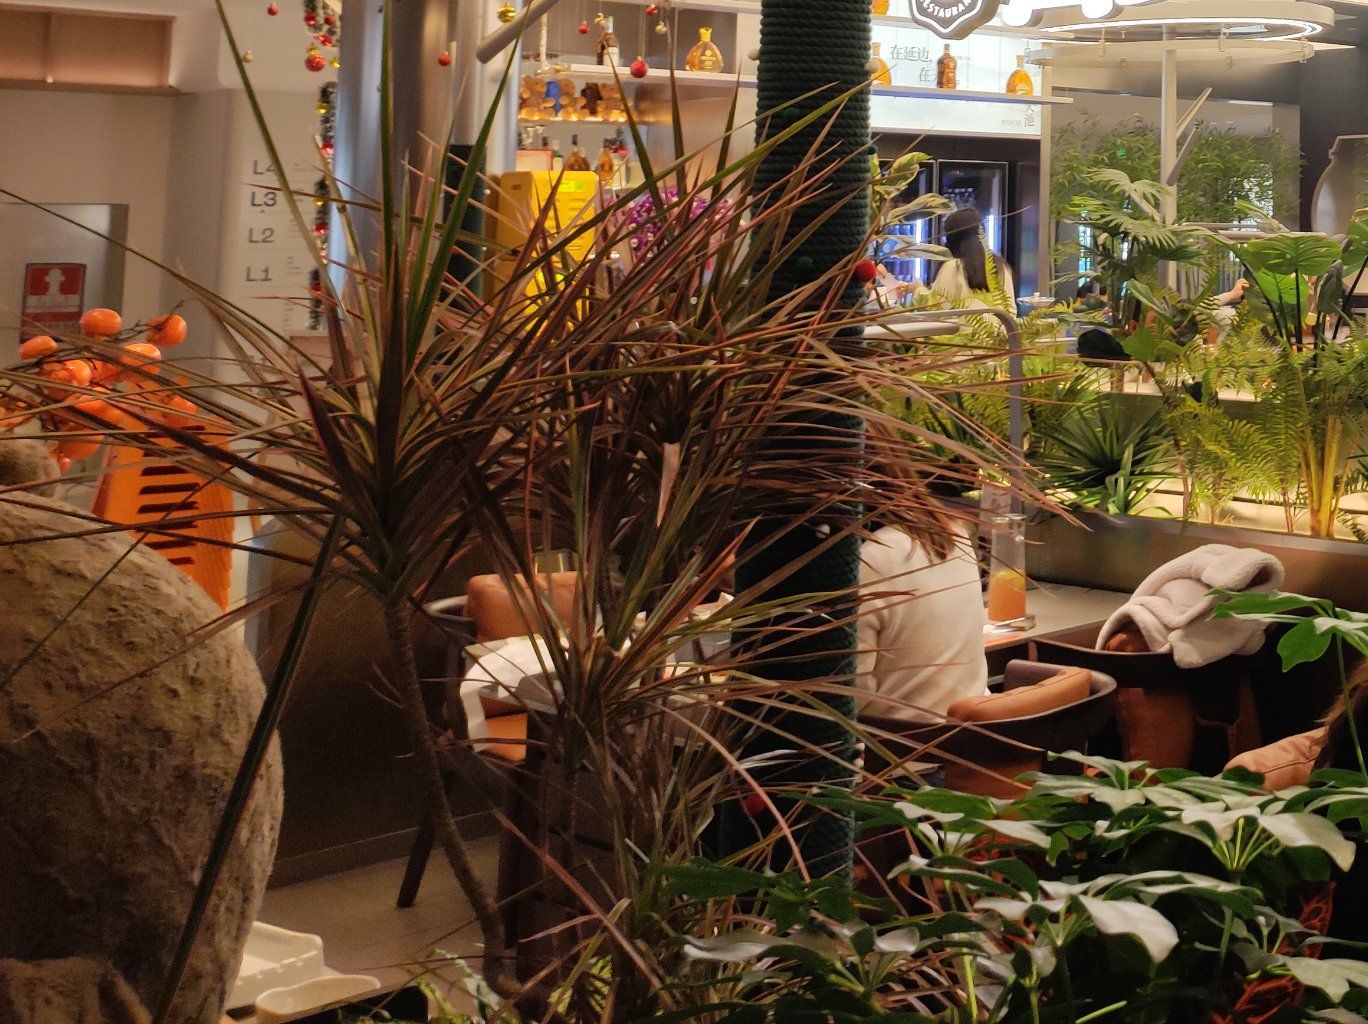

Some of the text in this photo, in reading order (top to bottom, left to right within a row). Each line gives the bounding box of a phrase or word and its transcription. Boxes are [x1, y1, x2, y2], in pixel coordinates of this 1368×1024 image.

[251, 191, 277, 207] L3
[248, 227, 275, 244] L2
[245, 266, 272, 282] L1
